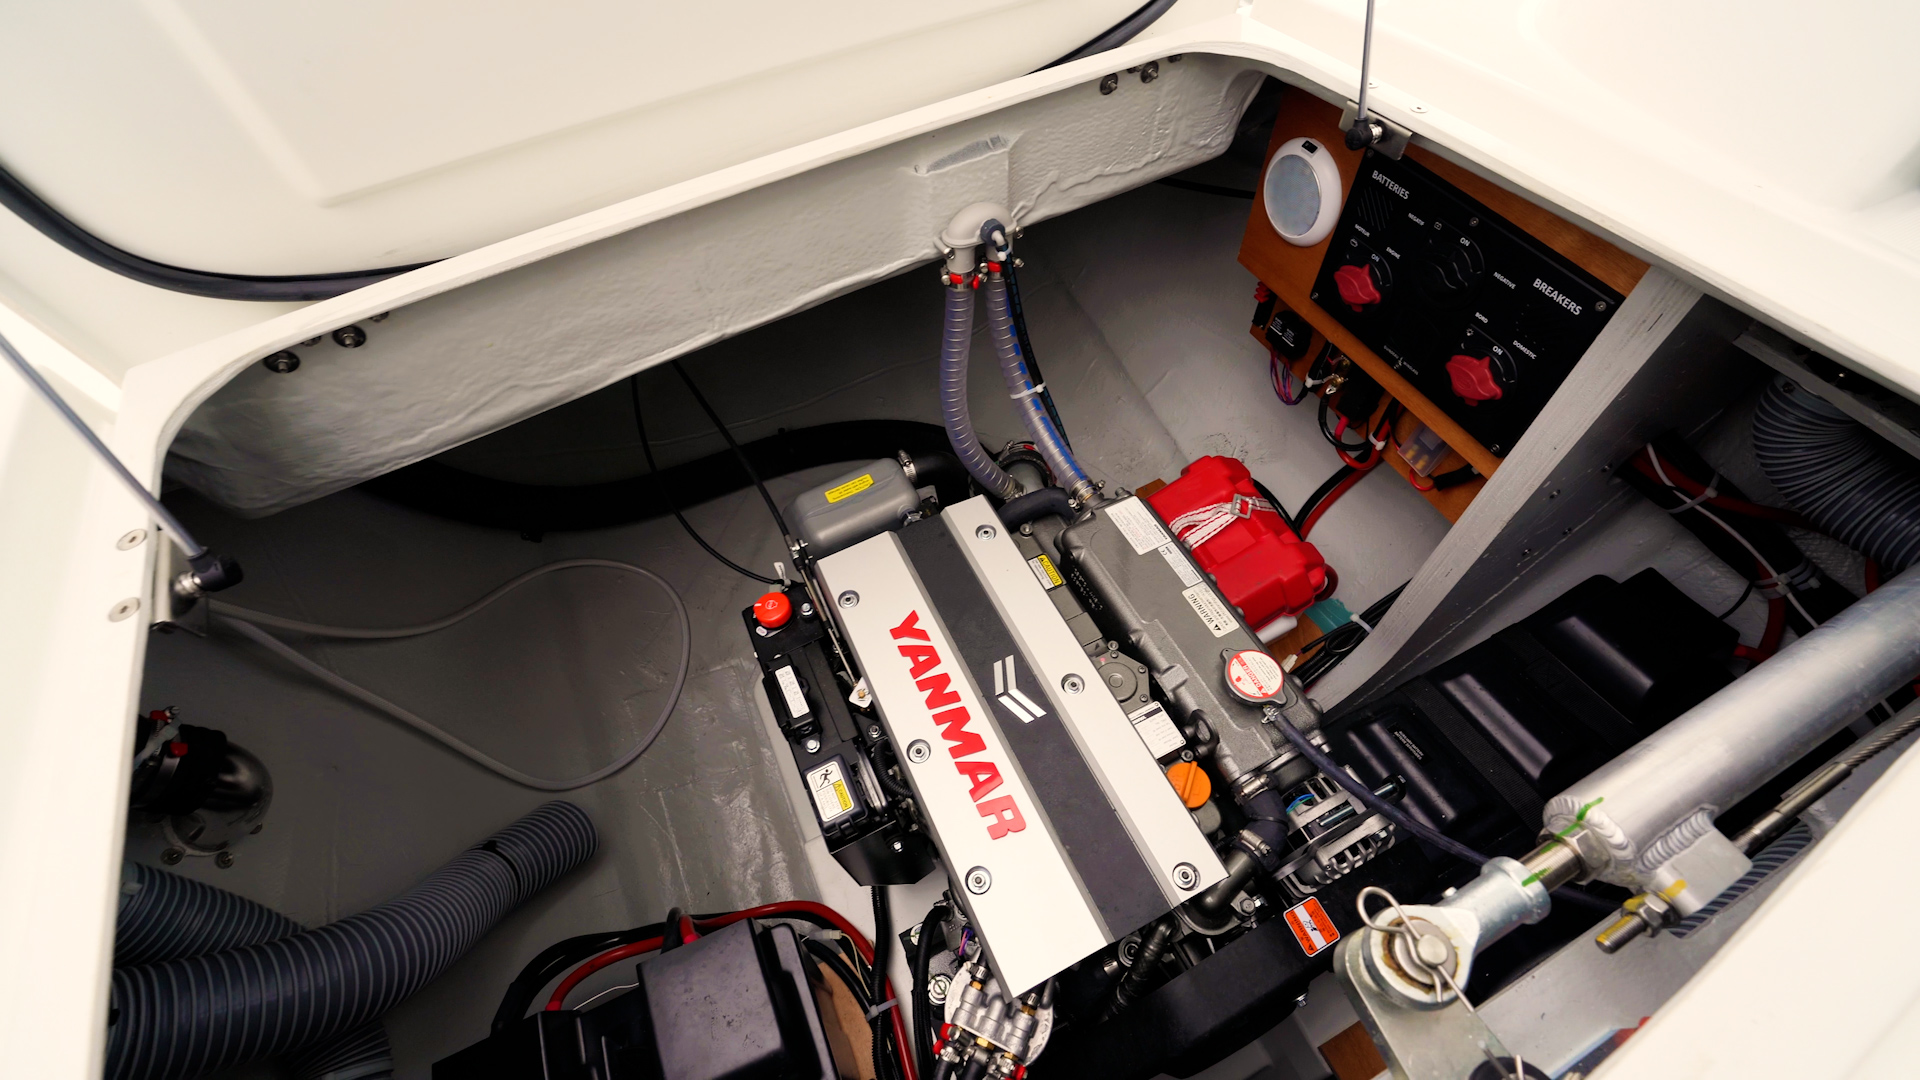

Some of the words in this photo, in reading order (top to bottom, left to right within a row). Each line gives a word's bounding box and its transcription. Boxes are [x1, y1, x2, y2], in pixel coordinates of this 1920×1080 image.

[1372, 169, 1410, 200] BATTERIES
[1459, 237, 1471, 247] ON
[1371, 253, 1380, 263] ON
[1386, 246, 1401, 260] ENGINE
[1493, 271, 1516, 290] NEGATIVE
[1533, 278, 1582, 316] BREAKERS
[1475, 311, 1488, 324] BORD
[1492, 345, 1503, 356] ON
[1512, 340, 1537, 360] DOMESTIC
[1044, 560, 1061, 584] CAUTION
[1190, 593, 1214, 624] WARNING
[1242, 664, 1262, 688] DANGER
[889, 610, 1027, 840] YANMAR
[838, 789, 848, 807] CAUTION
[1290, 911, 1310, 942] WARNING
